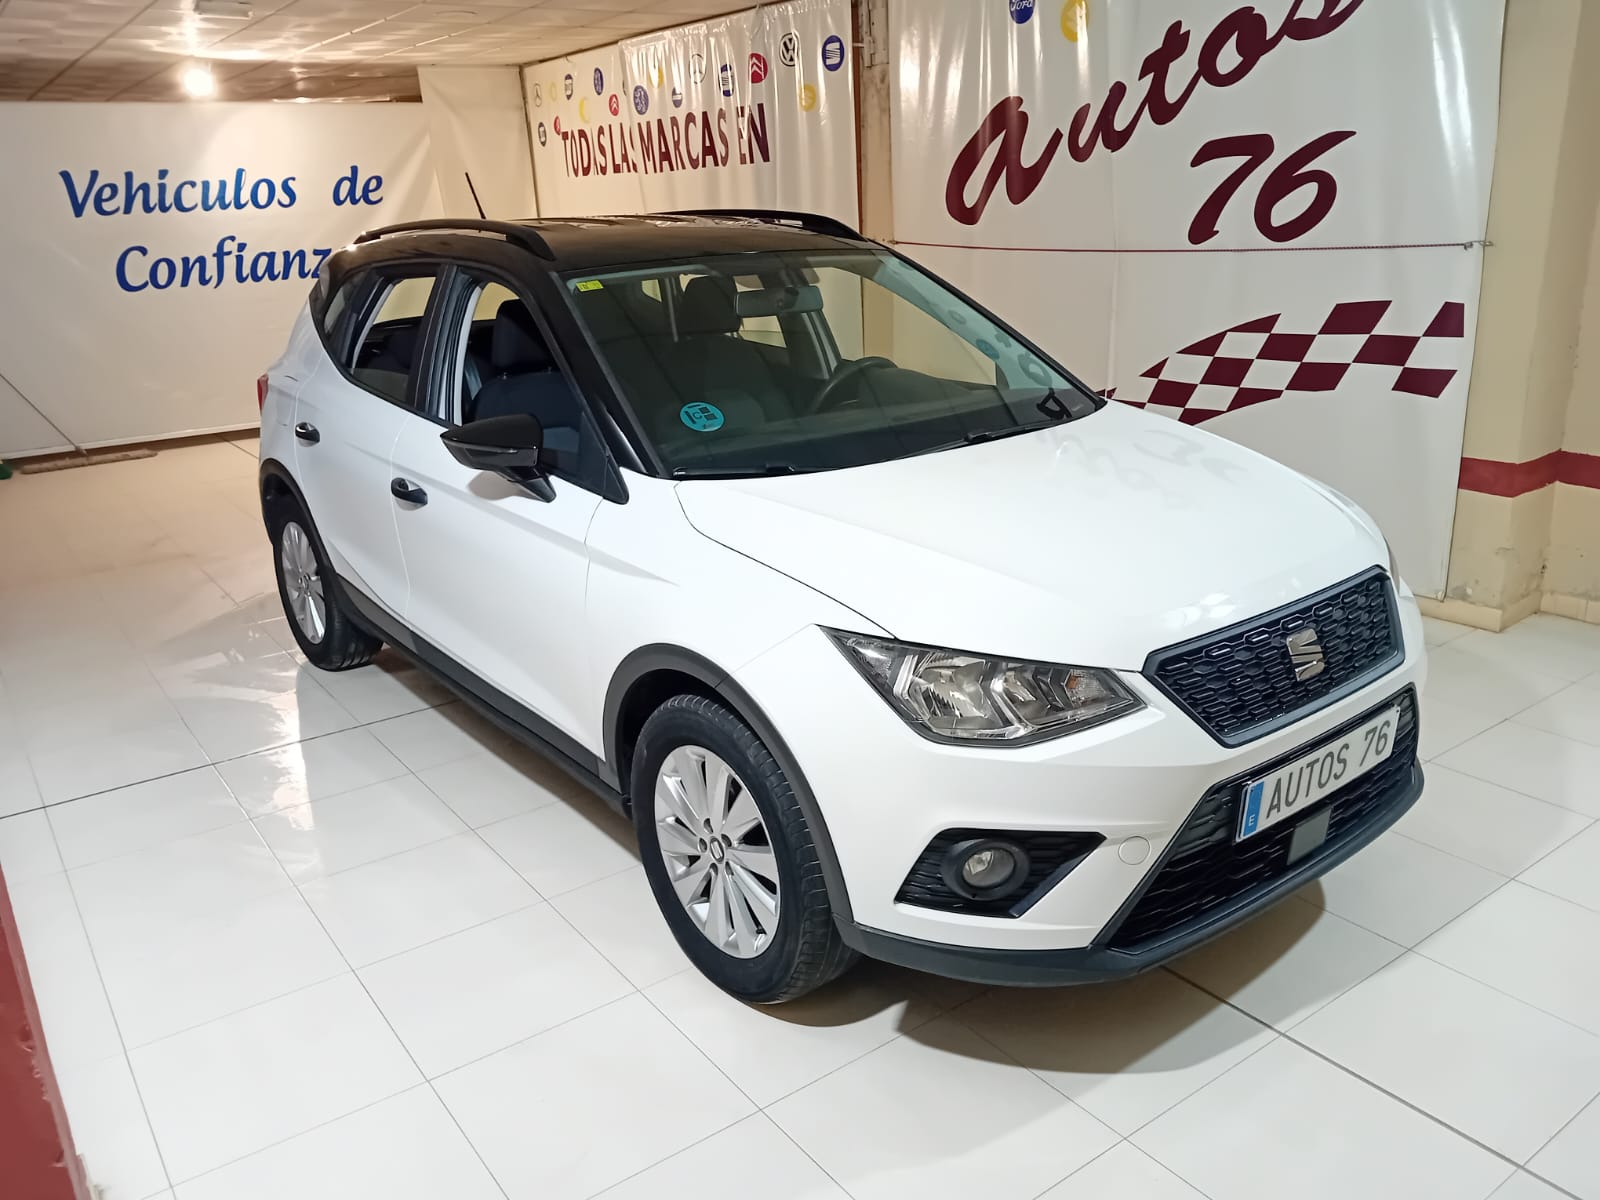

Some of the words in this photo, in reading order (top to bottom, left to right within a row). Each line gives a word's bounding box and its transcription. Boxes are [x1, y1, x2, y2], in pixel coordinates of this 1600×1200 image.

[637, 107, 729, 175] MARCAS
[736, 103, 770, 165] EN
[332, 165, 383, 206] de
[1188, 130, 1357, 245] 76
[1266, 743, 1350, 819] AUTOS
[1359, 720, 1391, 767] 76
